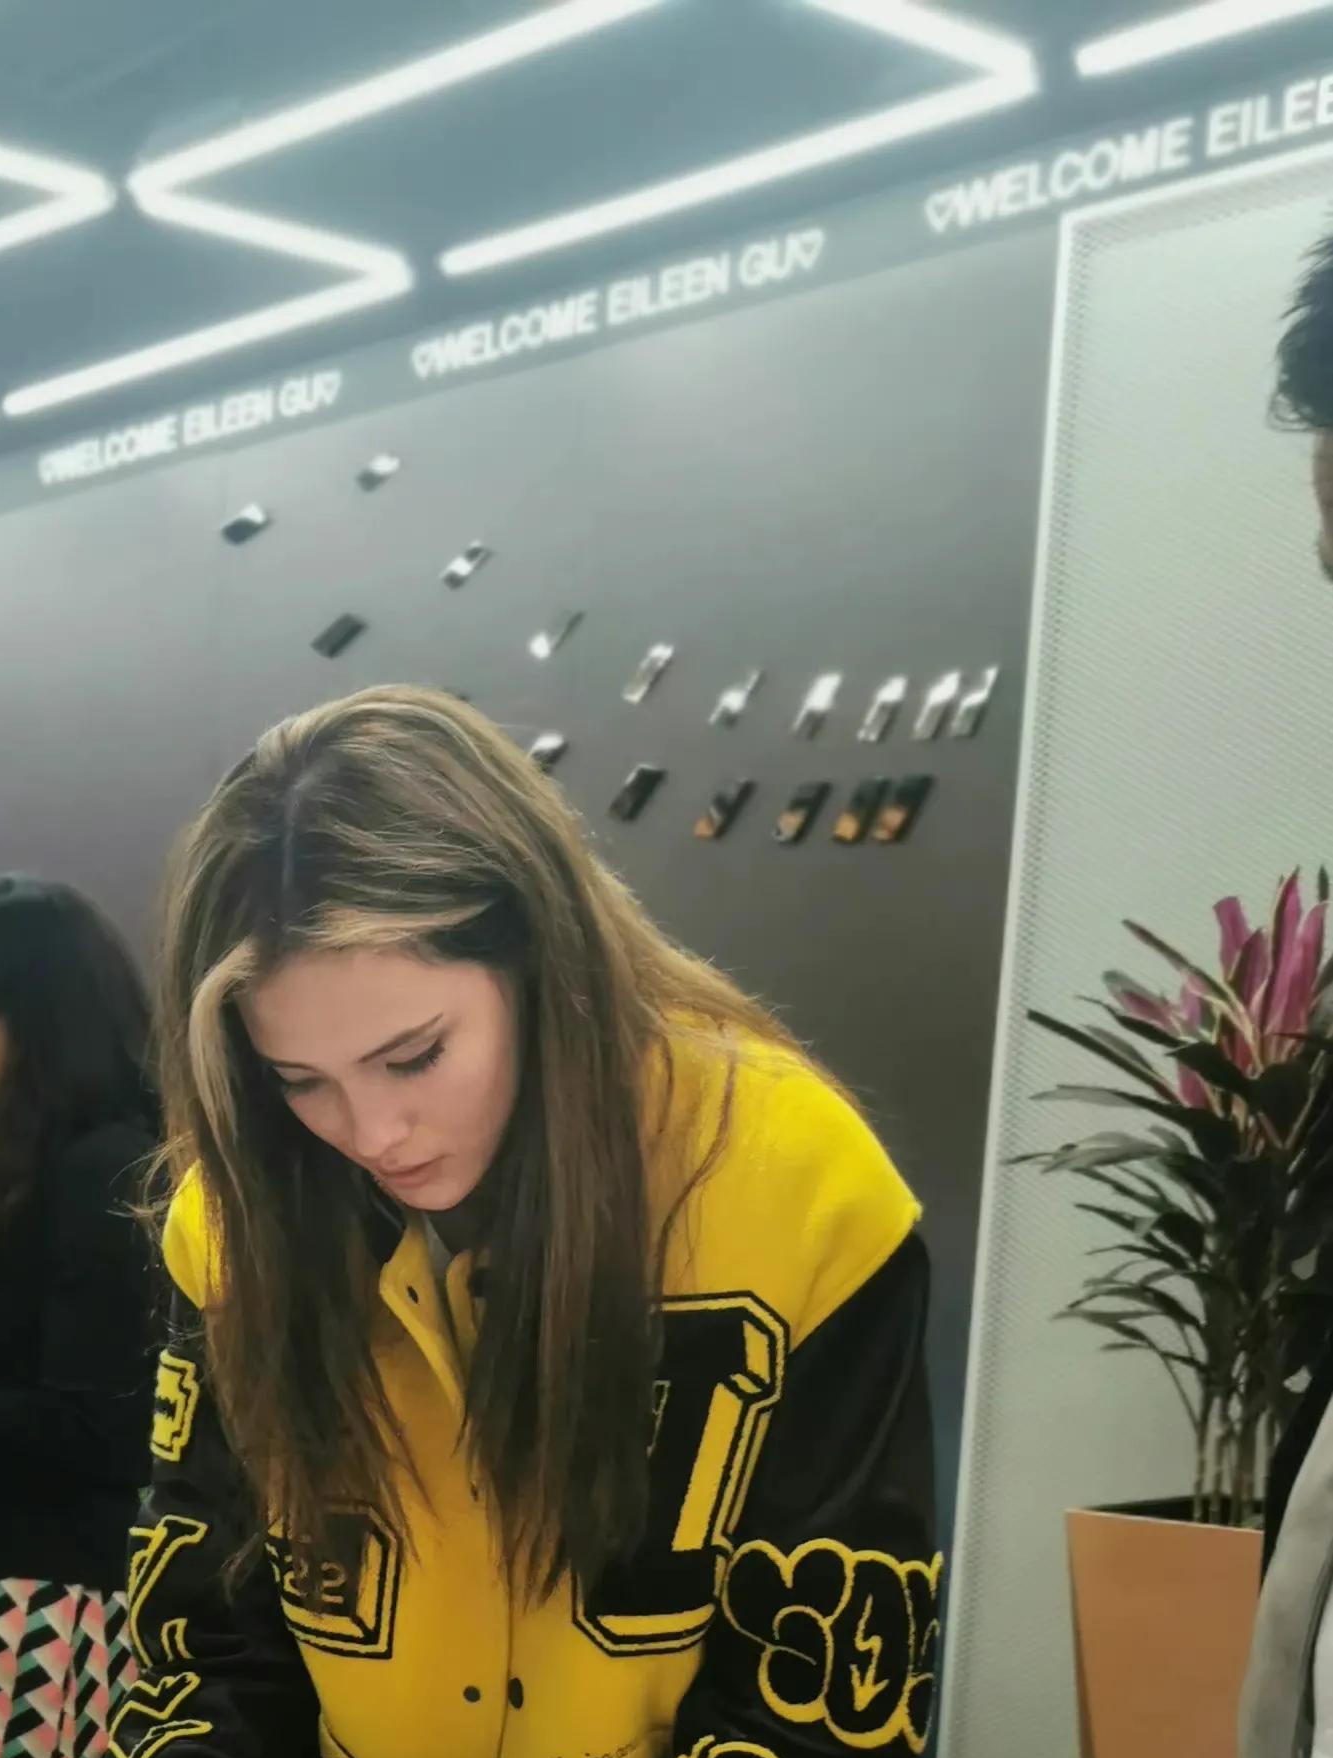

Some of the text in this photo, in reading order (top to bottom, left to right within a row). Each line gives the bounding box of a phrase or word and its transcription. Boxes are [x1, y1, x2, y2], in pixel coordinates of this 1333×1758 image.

[952, 112, 1195, 229] WELCOME
[431, 289, 599, 375] WELCOME
[606, 252, 731, 325] EILEEN
